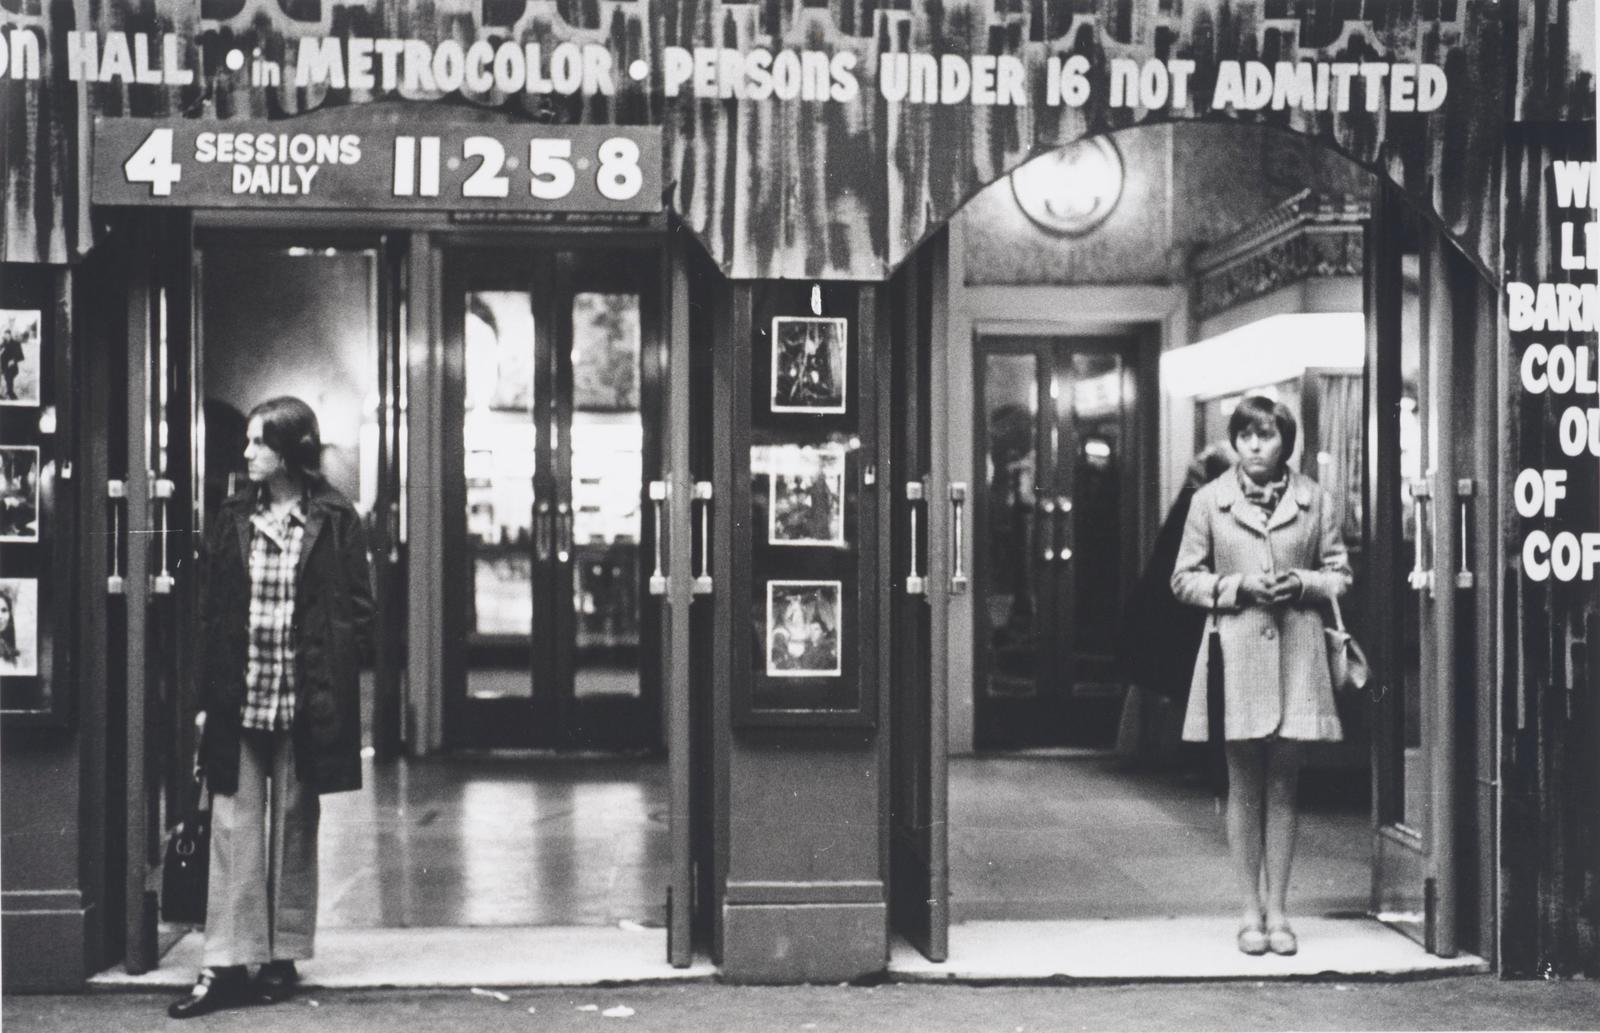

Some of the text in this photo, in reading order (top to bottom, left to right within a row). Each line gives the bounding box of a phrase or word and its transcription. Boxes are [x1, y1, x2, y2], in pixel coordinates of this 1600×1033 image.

[67, 30, 194, 85] HALL
[295, 36, 613, 96] METROCOLOR
[1046, 55, 1091, 107] 16
[1211, 60, 1449, 113] ADMITTED
[124, 128, 182, 196] 4
[195, 134, 362, 166] SESSIONS
[231, 164, 319, 195] DAILY
[1514, 468, 1568, 518] OF
